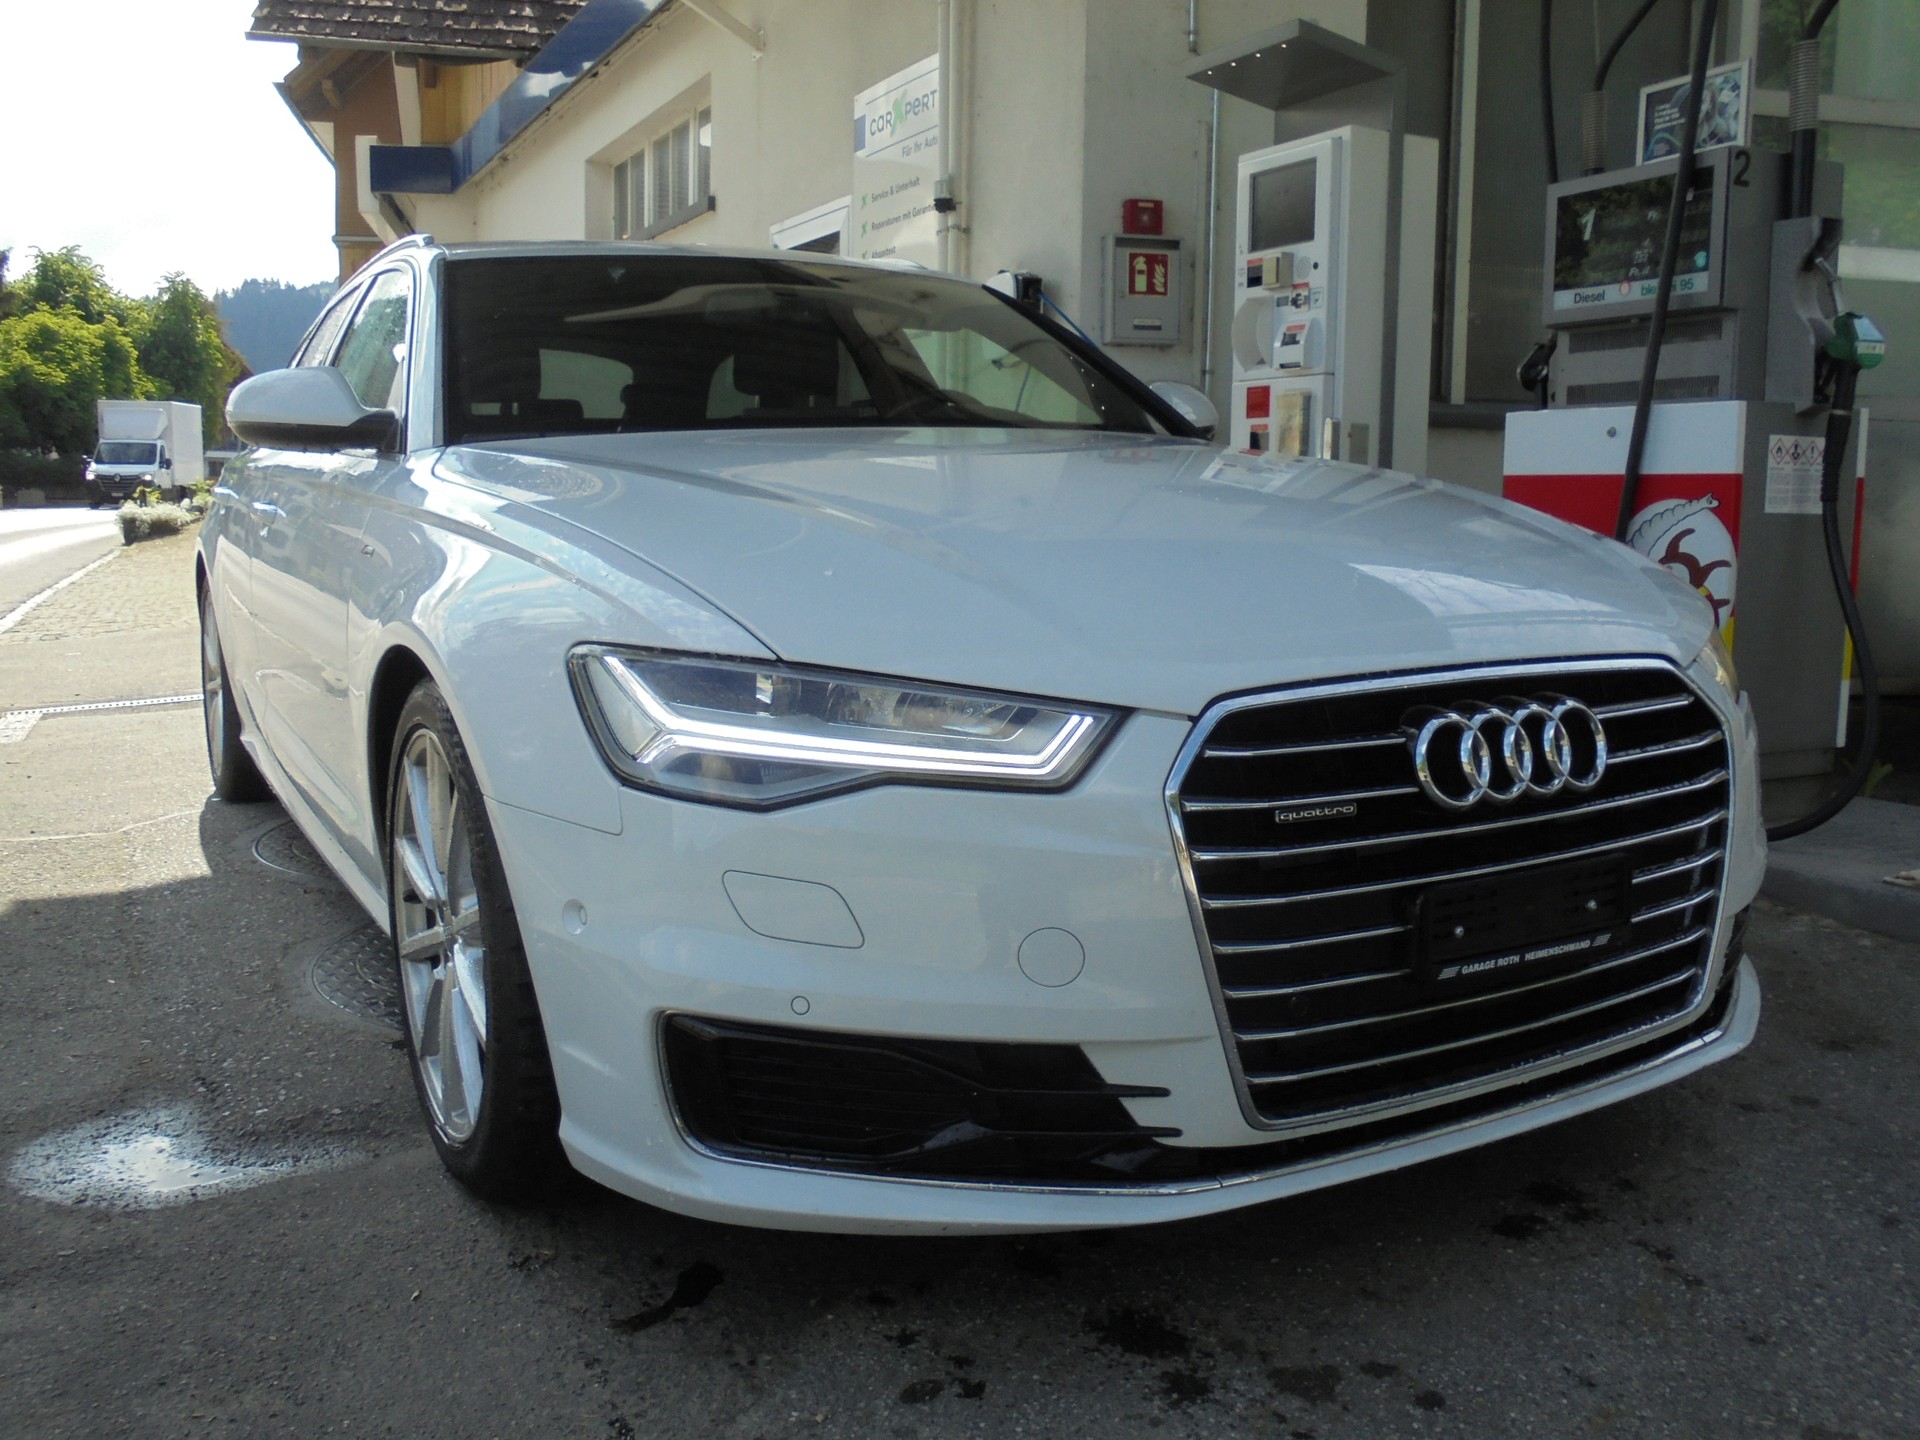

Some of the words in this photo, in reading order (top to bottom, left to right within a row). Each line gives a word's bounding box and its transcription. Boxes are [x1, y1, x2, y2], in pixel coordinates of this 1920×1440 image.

[902, 144, 913, 158] Für
[914, 140, 923, 154] Ihr
[1734, 149, 1751, 188] 2
[871, 190, 889, 203] Service
[890, 185, 895, 196] &
[895, 176, 920, 193] Unterhalt
[871, 215, 902, 231] Reparaturen
[902, 209, 912, 220] mit
[871, 245, 896, 259] Abgastest
[1680, 277, 1695, 291] 95
[1573, 290, 1606, 304] Diesel
[1280, 805, 1354, 821] quattro
[1461, 959, 1497, 974] GARAGE
[1497, 954, 1521, 968] ROTH
[1524, 940, 1591, 961] HEIMENSCHWAND
